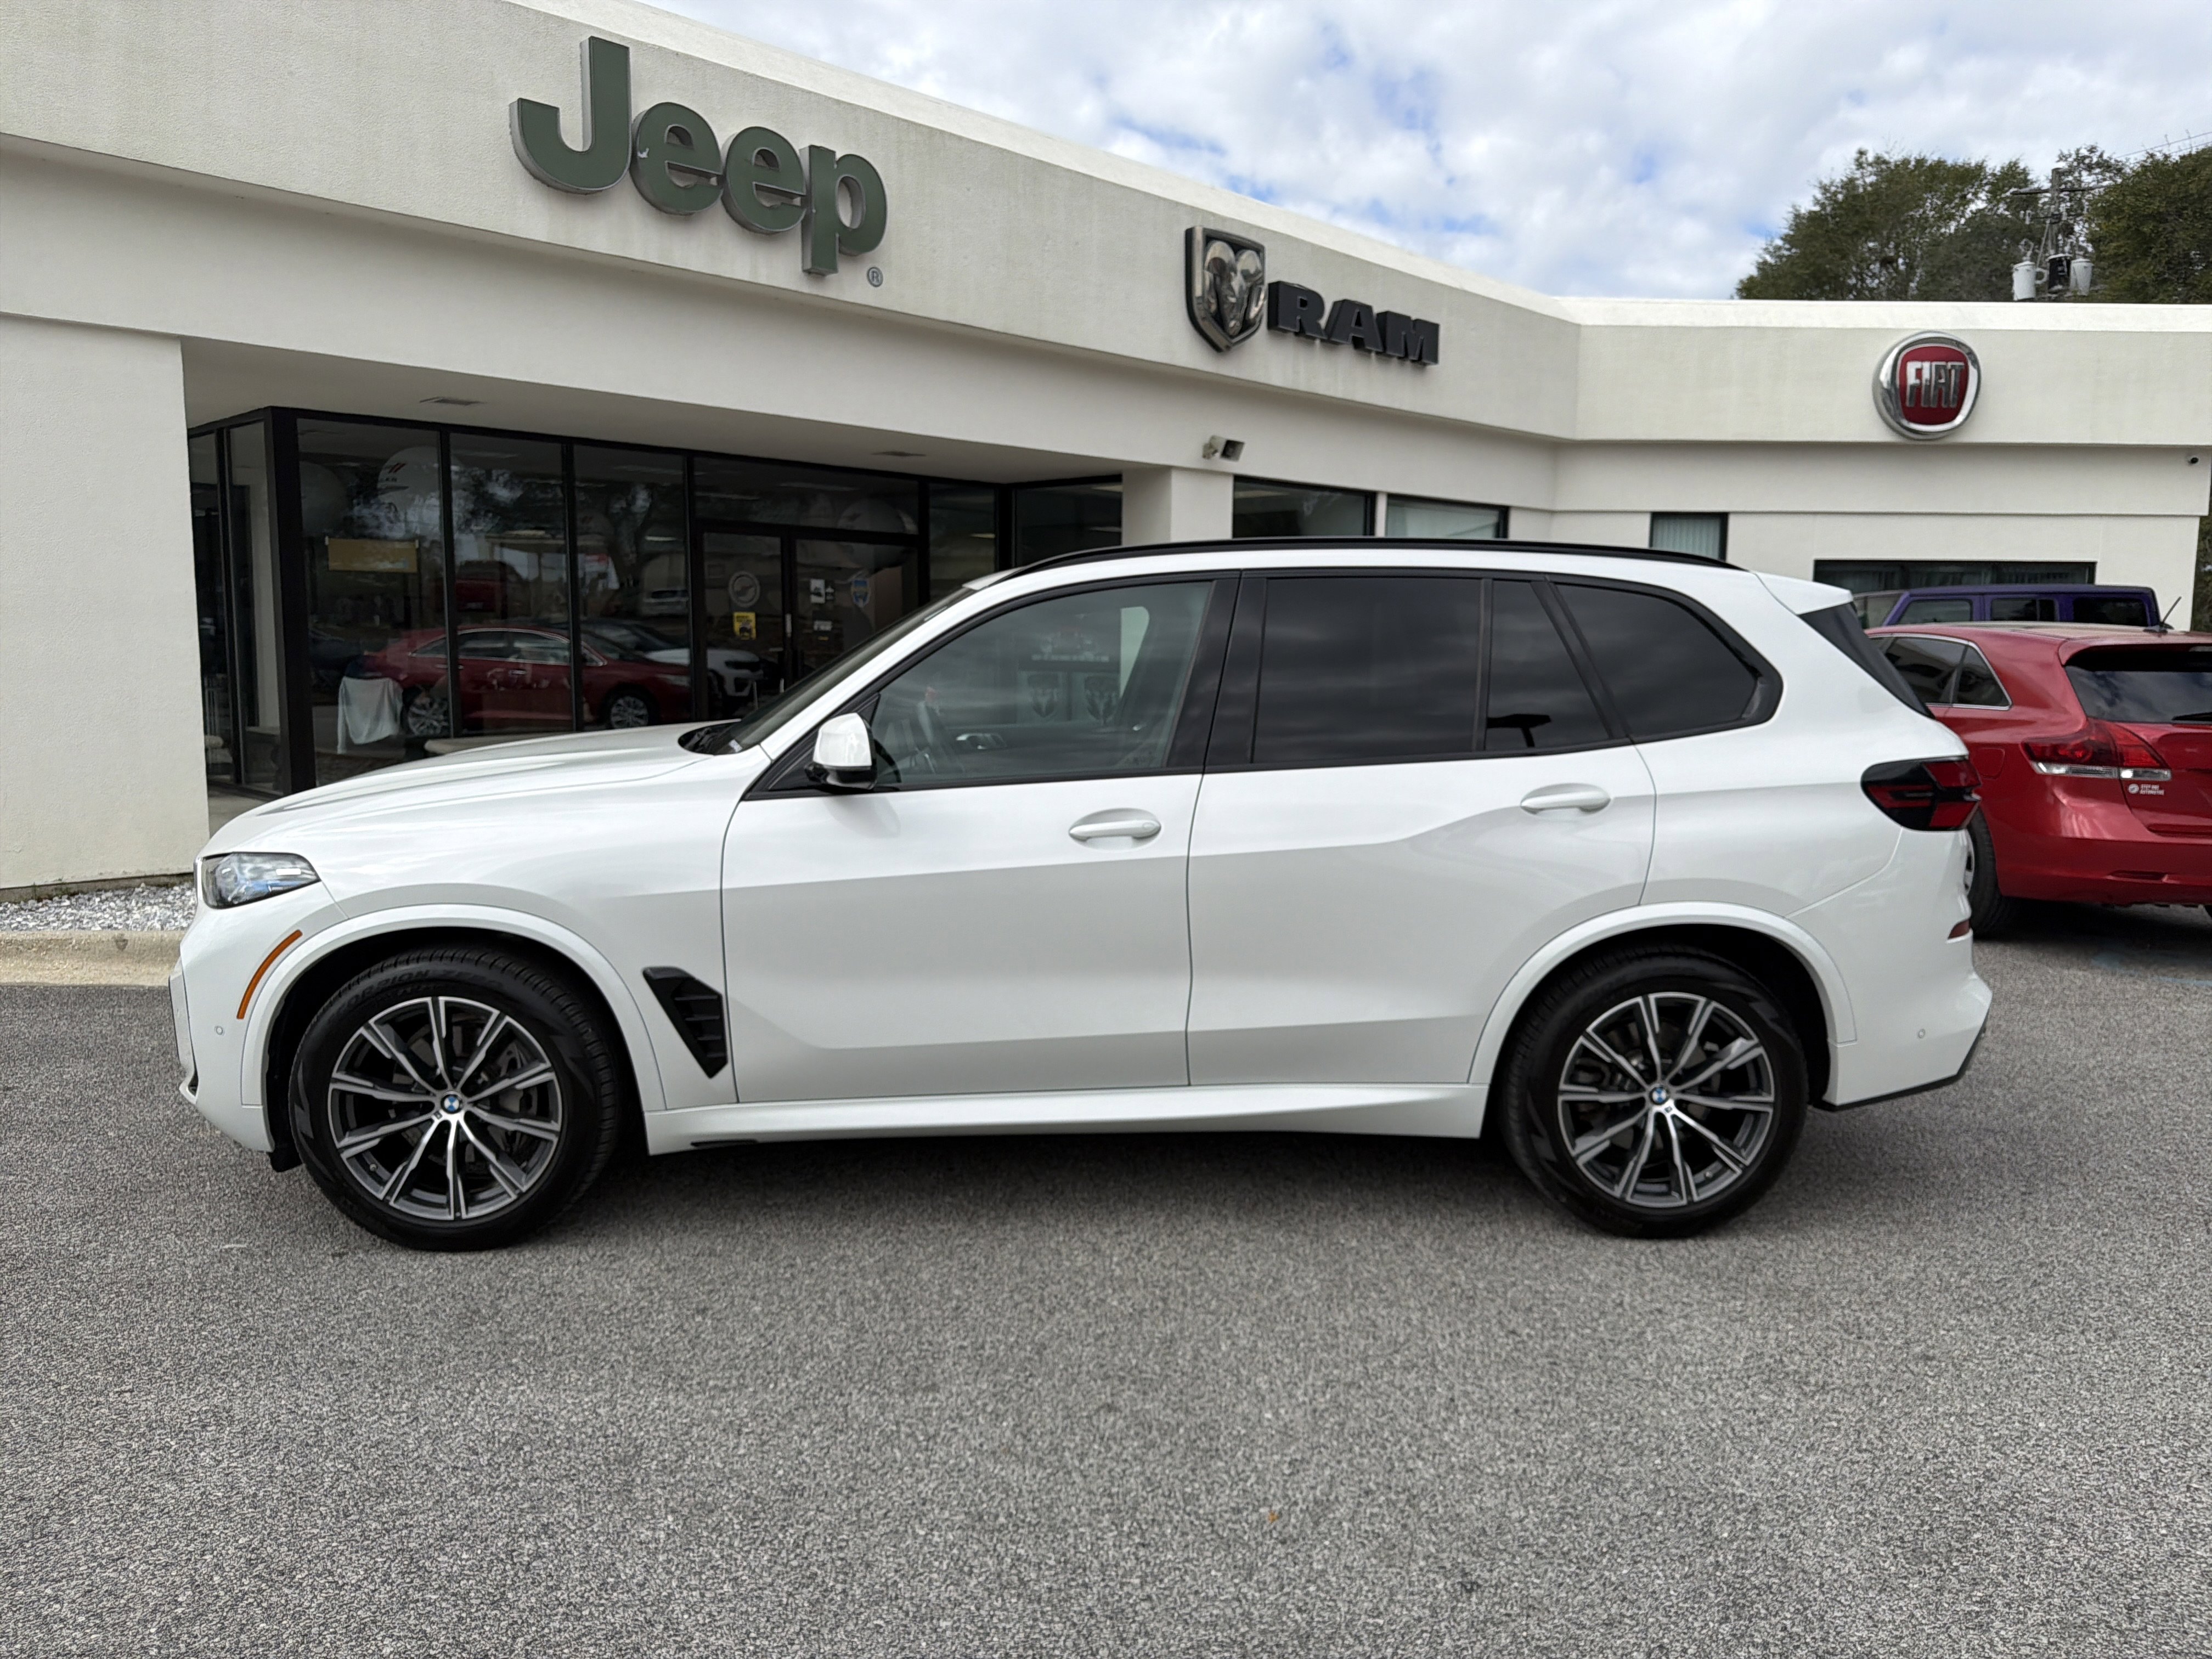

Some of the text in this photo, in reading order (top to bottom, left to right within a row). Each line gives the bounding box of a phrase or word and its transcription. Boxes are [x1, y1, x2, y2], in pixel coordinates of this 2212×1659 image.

[510, 36, 888, 276] Jeep
[1267, 280, 1440, 366] RAM
[1906, 360, 1965, 408] FIAT
